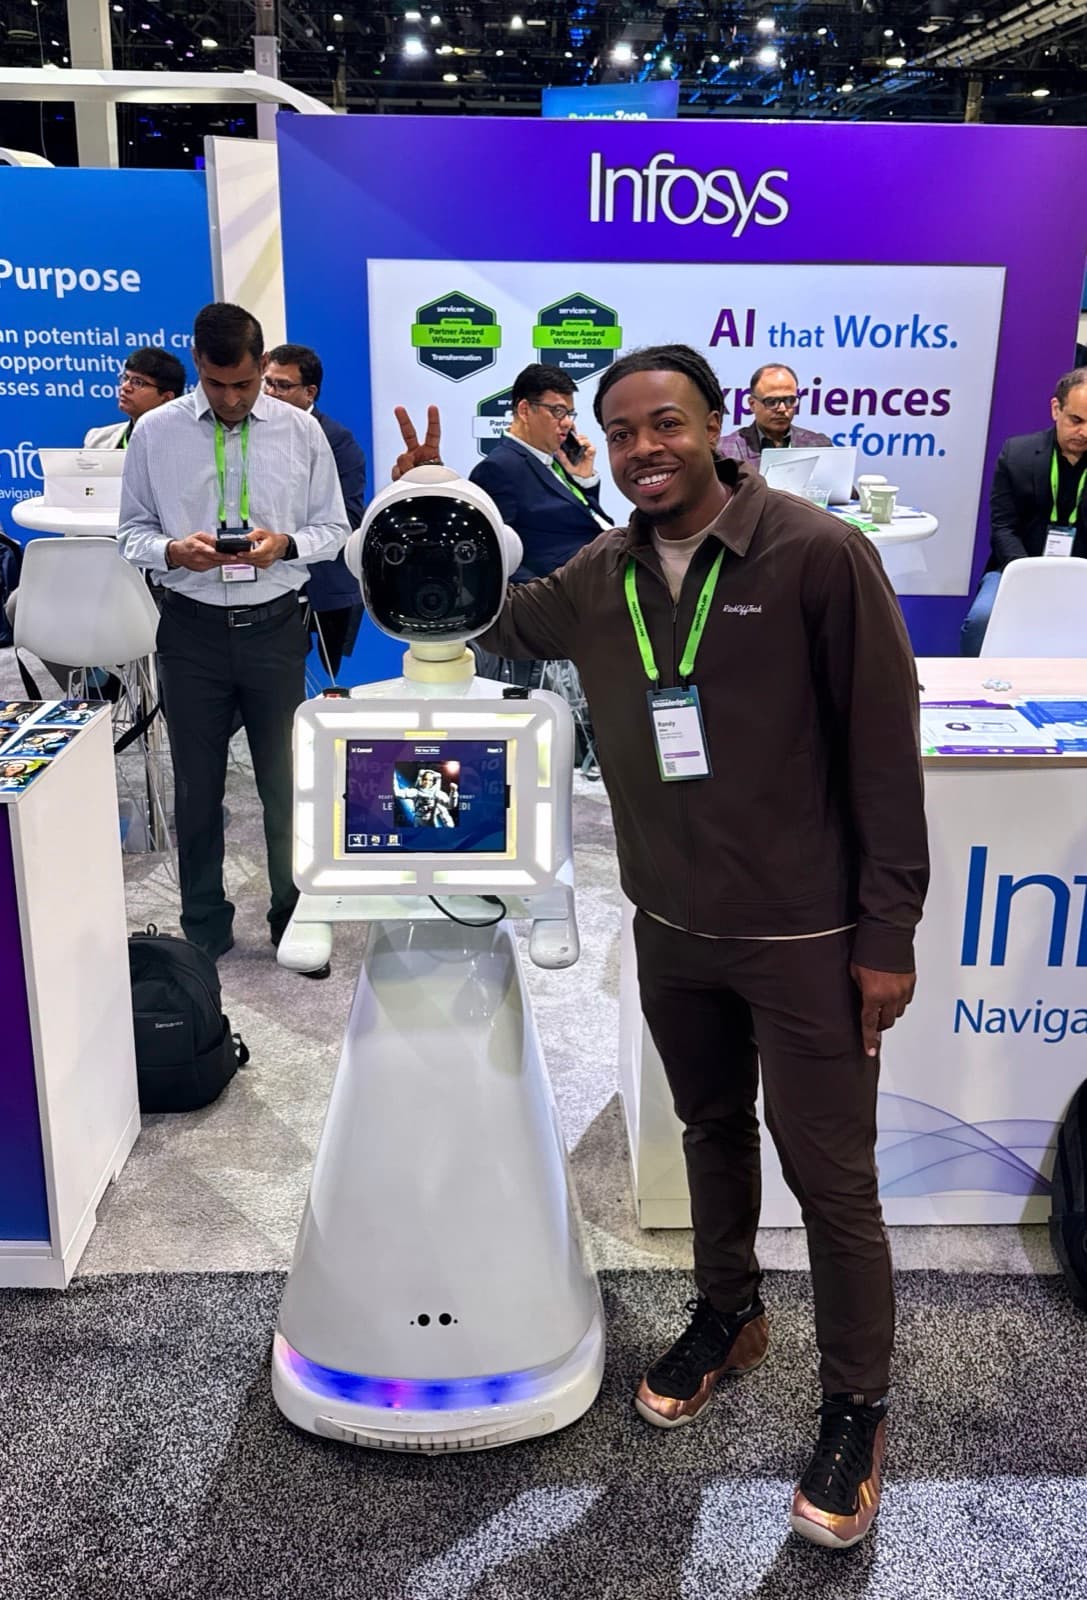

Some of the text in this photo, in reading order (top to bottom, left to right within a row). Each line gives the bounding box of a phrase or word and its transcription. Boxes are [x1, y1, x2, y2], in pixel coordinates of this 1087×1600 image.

[590, 152, 789, 238] Infosys
[0, 259, 141, 298] Purpose
[428, 327, 484, 336] Partner Award
[550, 329, 605, 337] Partner Award
[709, 308, 958, 349] AI that Works.
[24, 326, 119, 349] potential
[125, 328, 165, 348] and
[432, 336, 460, 344] Winner
[431, 353, 482, 361] Transformation
[567, 352, 588, 360] Talent
[559, 361, 595, 369] Excellence
[45, 379, 84, 398] and
